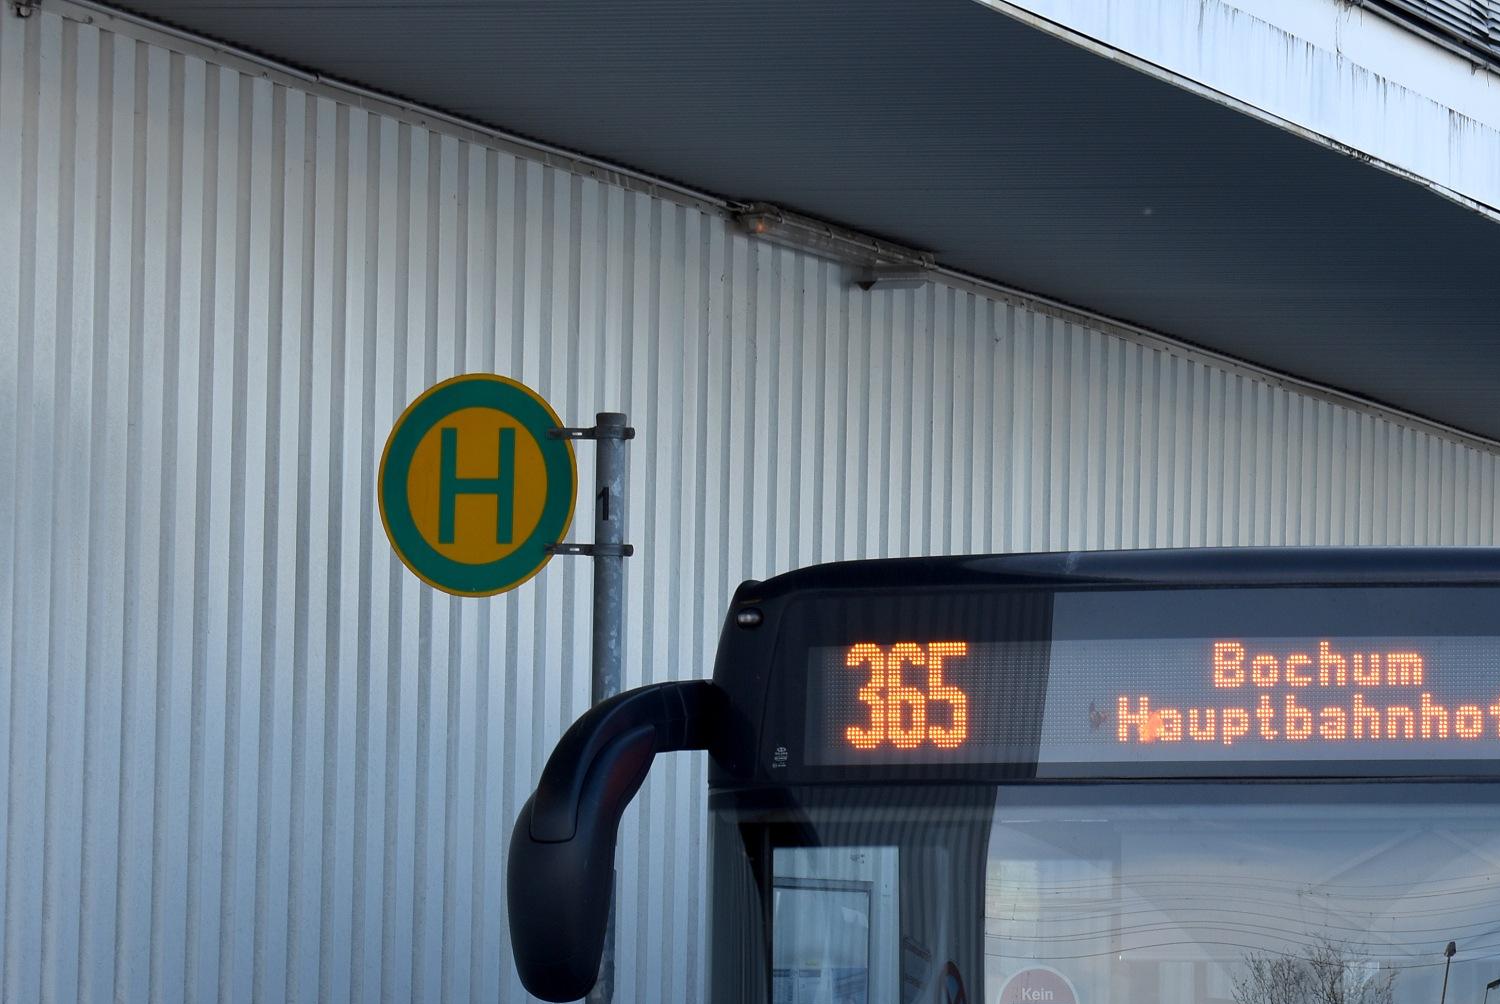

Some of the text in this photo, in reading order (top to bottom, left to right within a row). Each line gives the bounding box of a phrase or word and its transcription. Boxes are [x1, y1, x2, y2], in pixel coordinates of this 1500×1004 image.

[438, 427, 516, 544] H
[845, 642, 968, 750] 365
[1213, 641, 1424, 689] Bochum
[1021, 987, 1054, 1001] Kein
